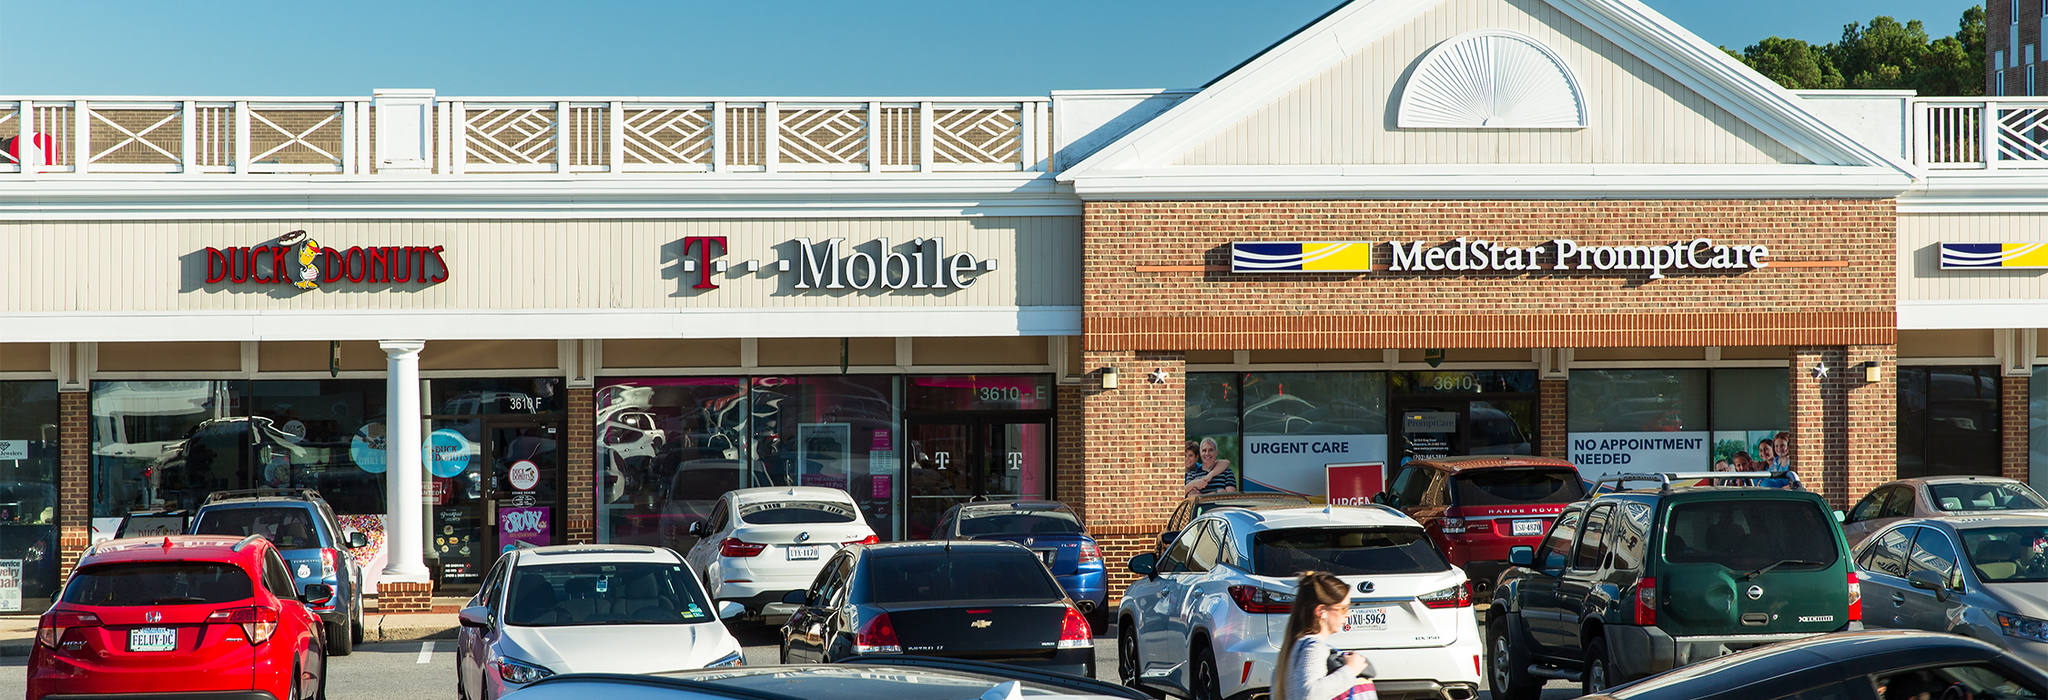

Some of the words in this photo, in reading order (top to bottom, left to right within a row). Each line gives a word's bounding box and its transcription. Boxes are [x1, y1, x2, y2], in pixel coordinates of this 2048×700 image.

[206, 245, 292, 284] DUCK
[323, 245, 449, 284] DONUTS
[1389, 237, 1545, 271] MedStar
[1553, 238, 1769, 279] PromptCare
[1433, 376, 1472, 390] 3610
[980, 387, 1019, 400] 3610
[1036, 386, 1047, 400] E
[510, 397, 533, 410] 3610
[536, 397, 542, 409] F
[1250, 442, 1308, 454] URGENT
[1311, 441, 1349, 453] CARE
[1574, 440, 1596, 450] NO
[1600, 438, 1703, 450] APPOINTMENT
[1574, 453, 1632, 464] NEEDED
